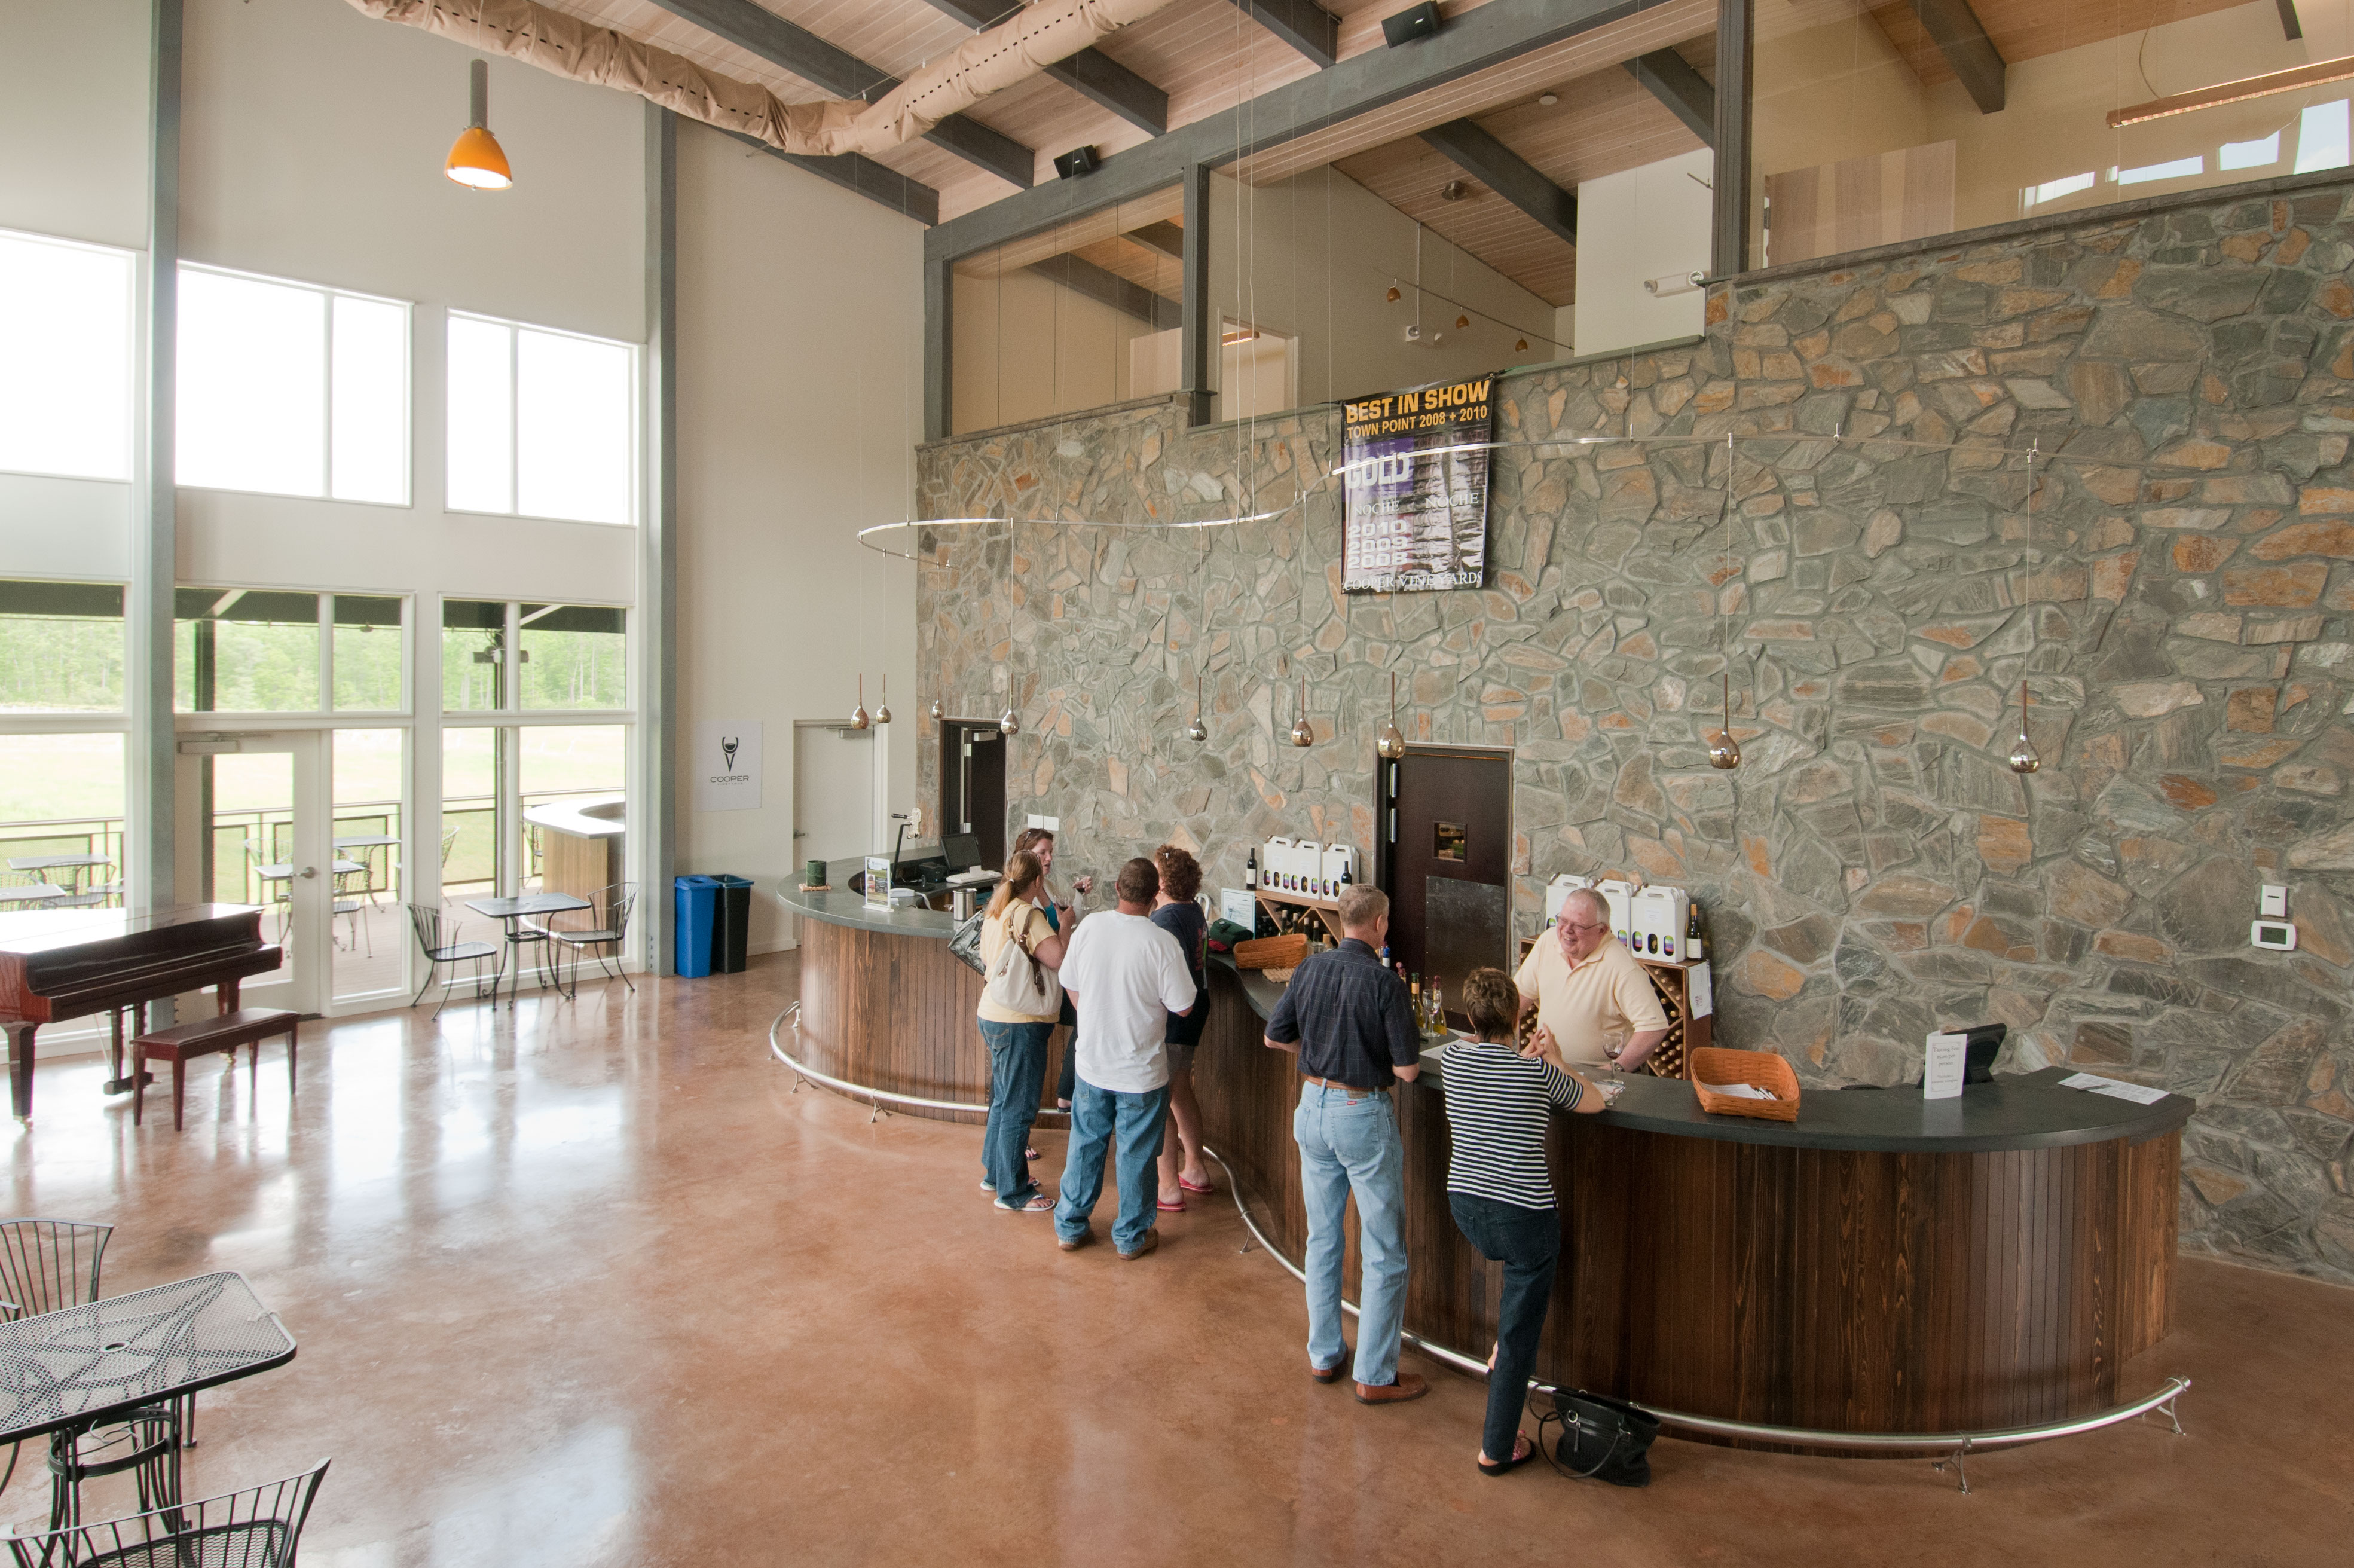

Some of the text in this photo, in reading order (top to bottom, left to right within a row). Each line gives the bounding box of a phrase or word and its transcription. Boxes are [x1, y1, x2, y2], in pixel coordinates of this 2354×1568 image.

[1346, 380, 1490, 424] BEST IN SHOW
[1347, 405, 1487, 439] TOWN POINT 2008 + 2010
[1345, 451, 1410, 489] GOLD
[1354, 500, 1399, 516] NOCHE
[1424, 492, 1479, 508] NOCHE
[1348, 519, 1407, 538] 2010
[1347, 536, 1408, 555] 2009
[1347, 551, 1408, 570] 2008
[1344, 571, 1482, 591] COOPER VINEYARDS
